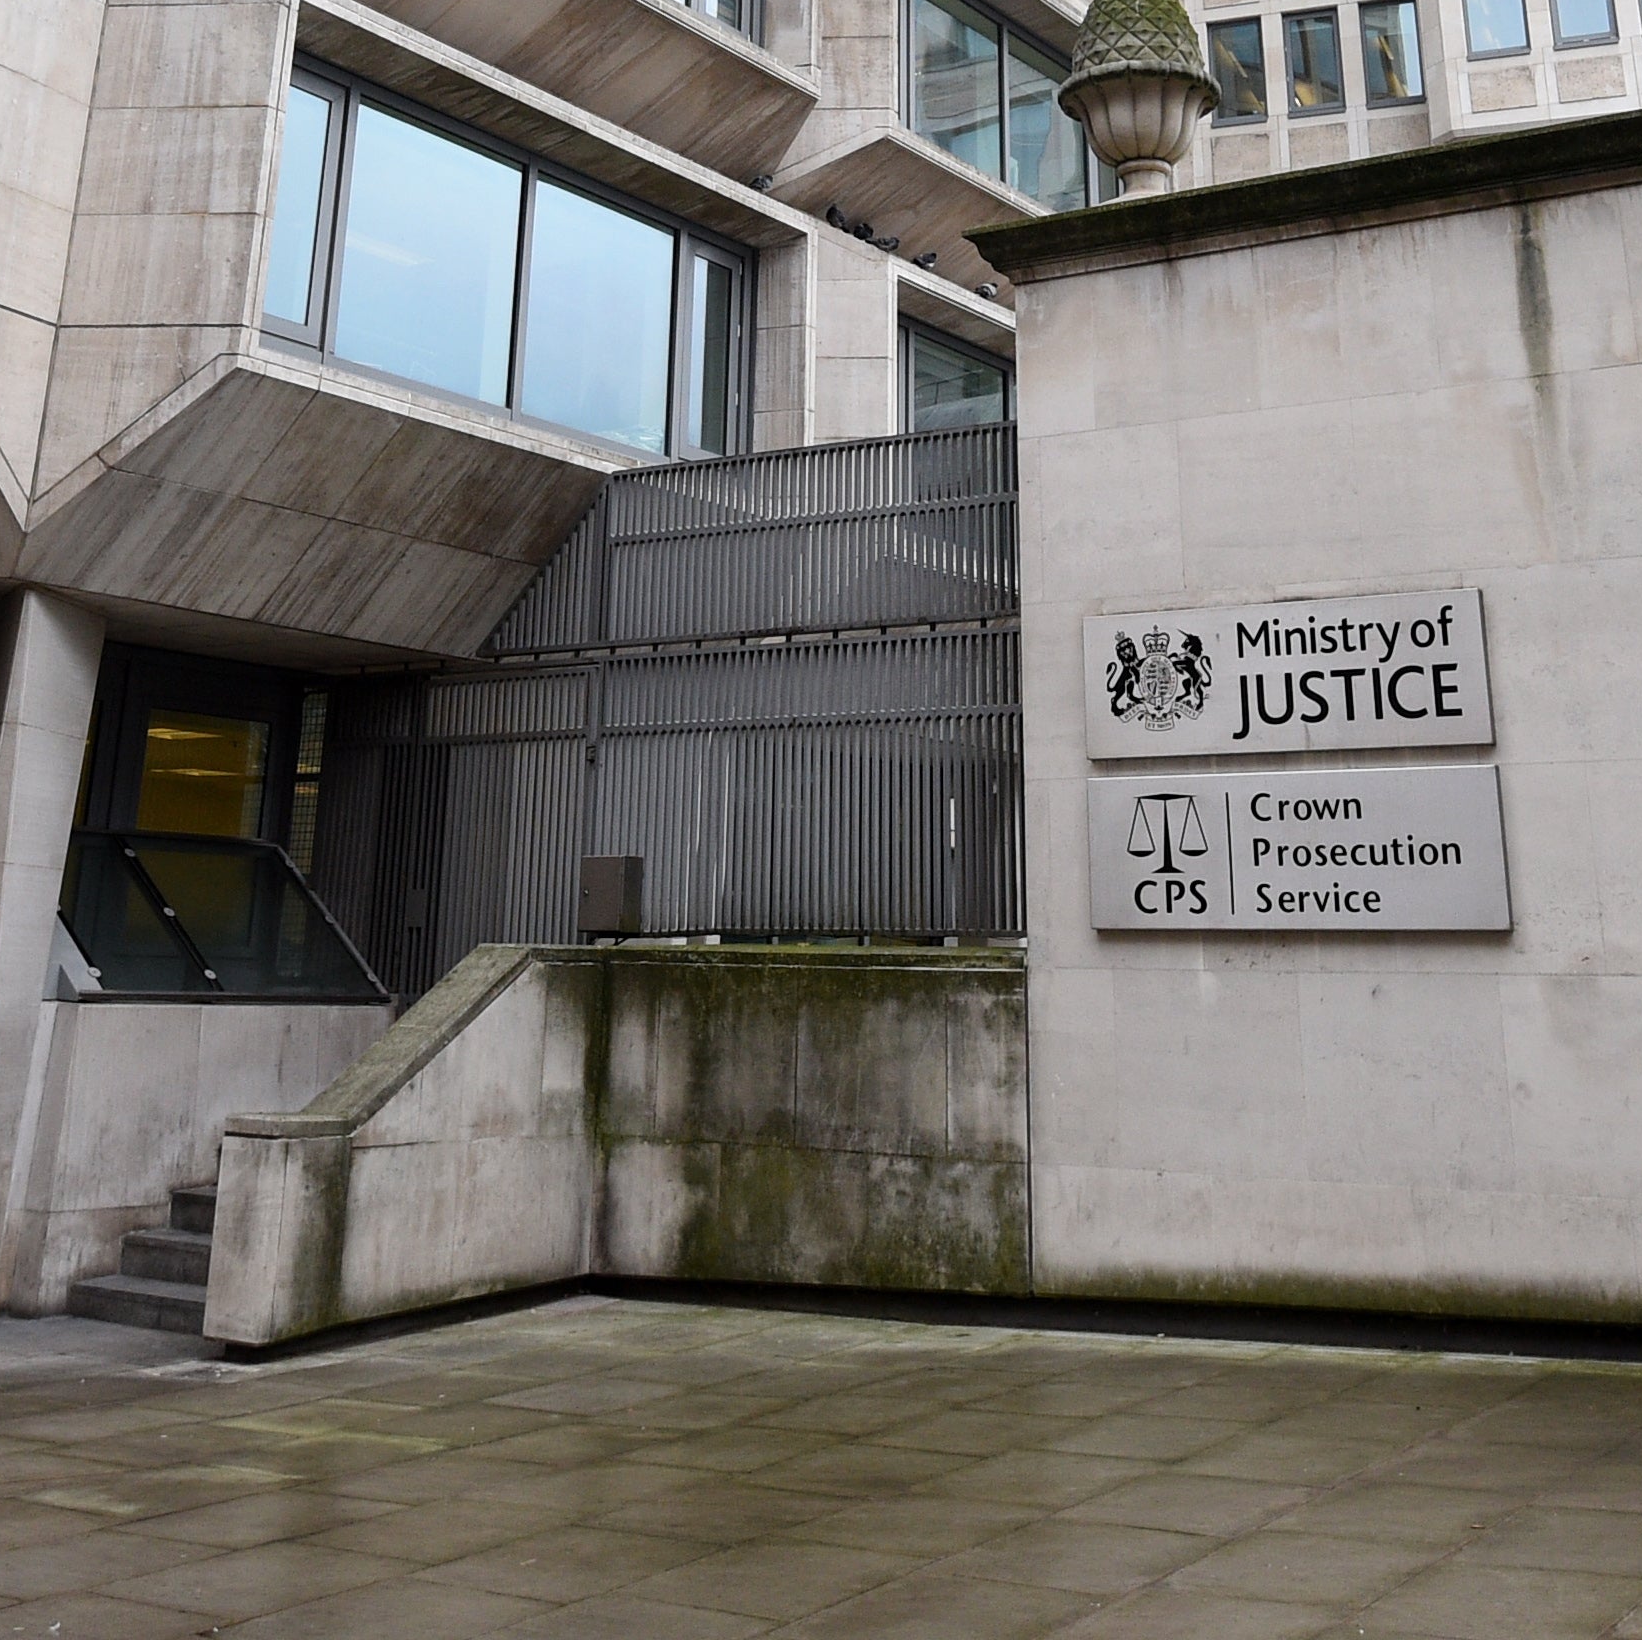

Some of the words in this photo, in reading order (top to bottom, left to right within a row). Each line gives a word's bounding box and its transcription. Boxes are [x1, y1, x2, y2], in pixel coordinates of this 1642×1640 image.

[1236, 615, 1401, 664] Ministry
[1410, 604, 1454, 648] of
[1232, 662, 1464, 741] JUSTICE
[1250, 792, 1363, 822] Crown
[1252, 834, 1462, 868] Prosecution
[1133, 879, 1209, 915] CPS
[1256, 881, 1382, 915] Service
